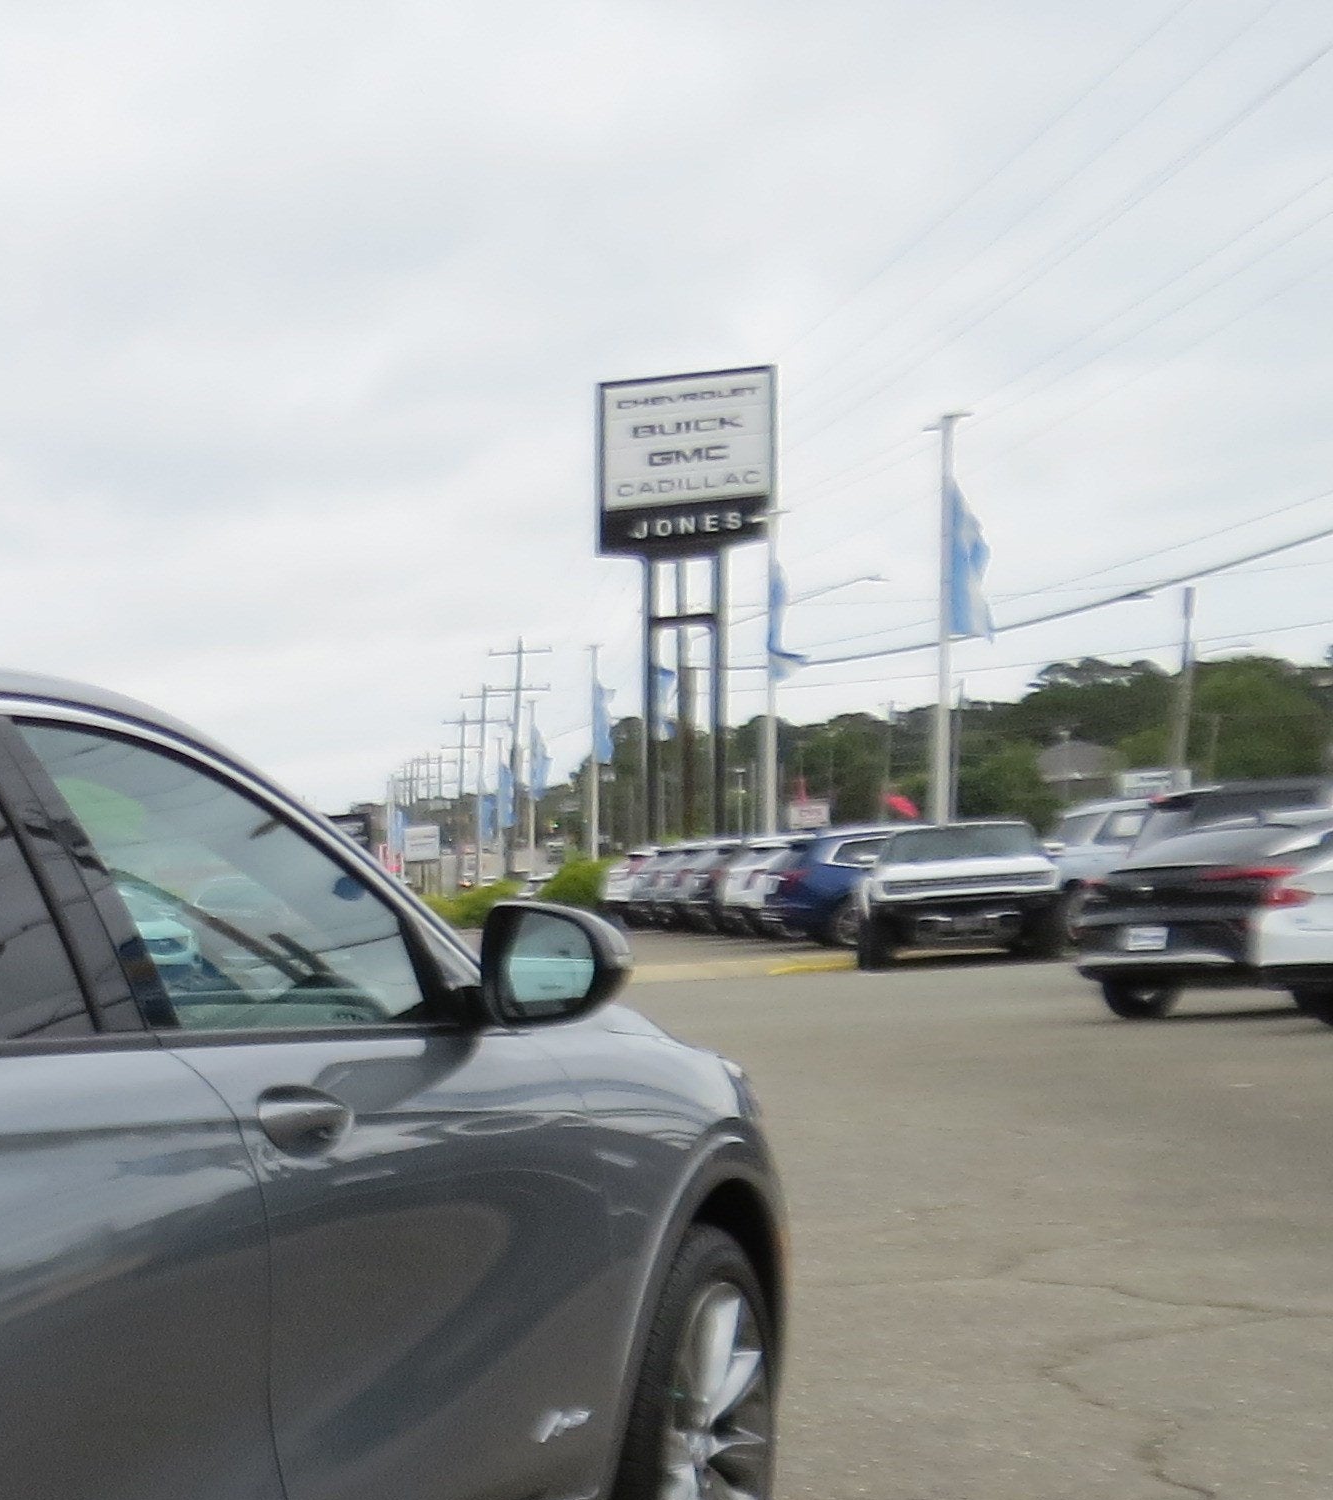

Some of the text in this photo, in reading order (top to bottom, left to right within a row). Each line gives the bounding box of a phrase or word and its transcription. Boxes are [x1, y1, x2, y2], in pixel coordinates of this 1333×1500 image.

[617, 386, 759, 410] CHEVROLET
[632, 415, 743, 439] BUICK
[648, 445, 729, 467] GMC
[617, 470, 760, 498] CADILLAC
[632, 511, 742, 539] JONES
